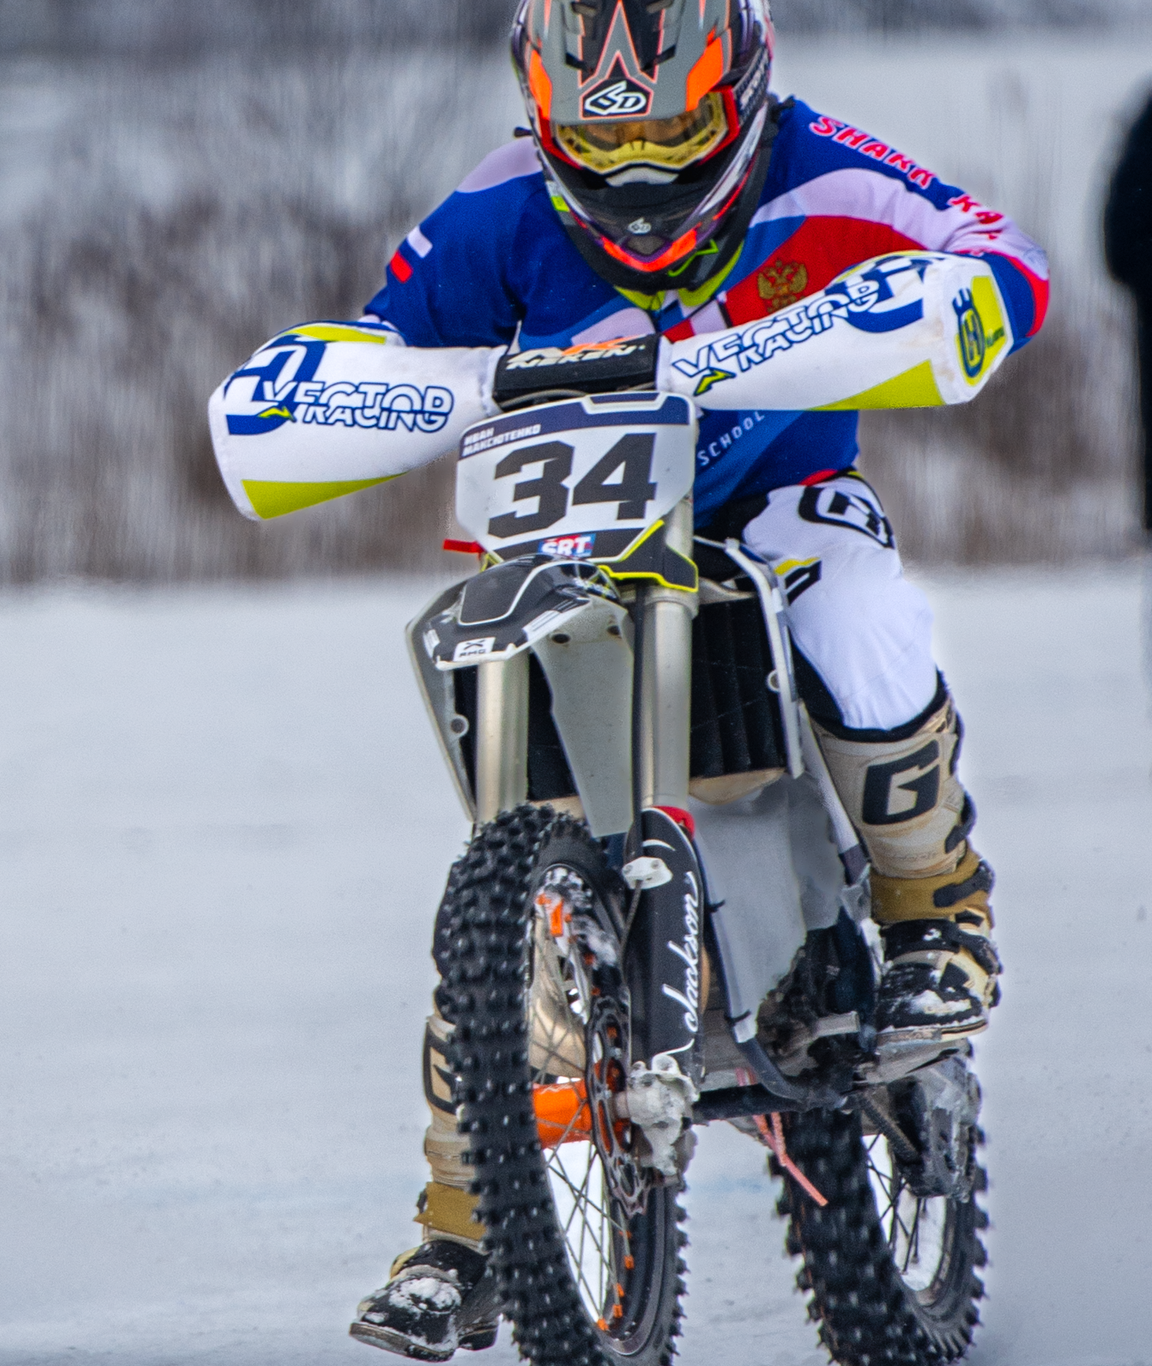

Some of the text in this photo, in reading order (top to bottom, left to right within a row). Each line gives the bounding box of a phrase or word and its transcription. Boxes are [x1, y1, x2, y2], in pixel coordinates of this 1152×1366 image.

[584, 80, 647, 115] 6D
[697, 410, 766, 467] SCHOOL
[487, 432, 658, 539] 34
[862, 739, 940, 825] G
[662, 870, 699, 1033] Jackson
